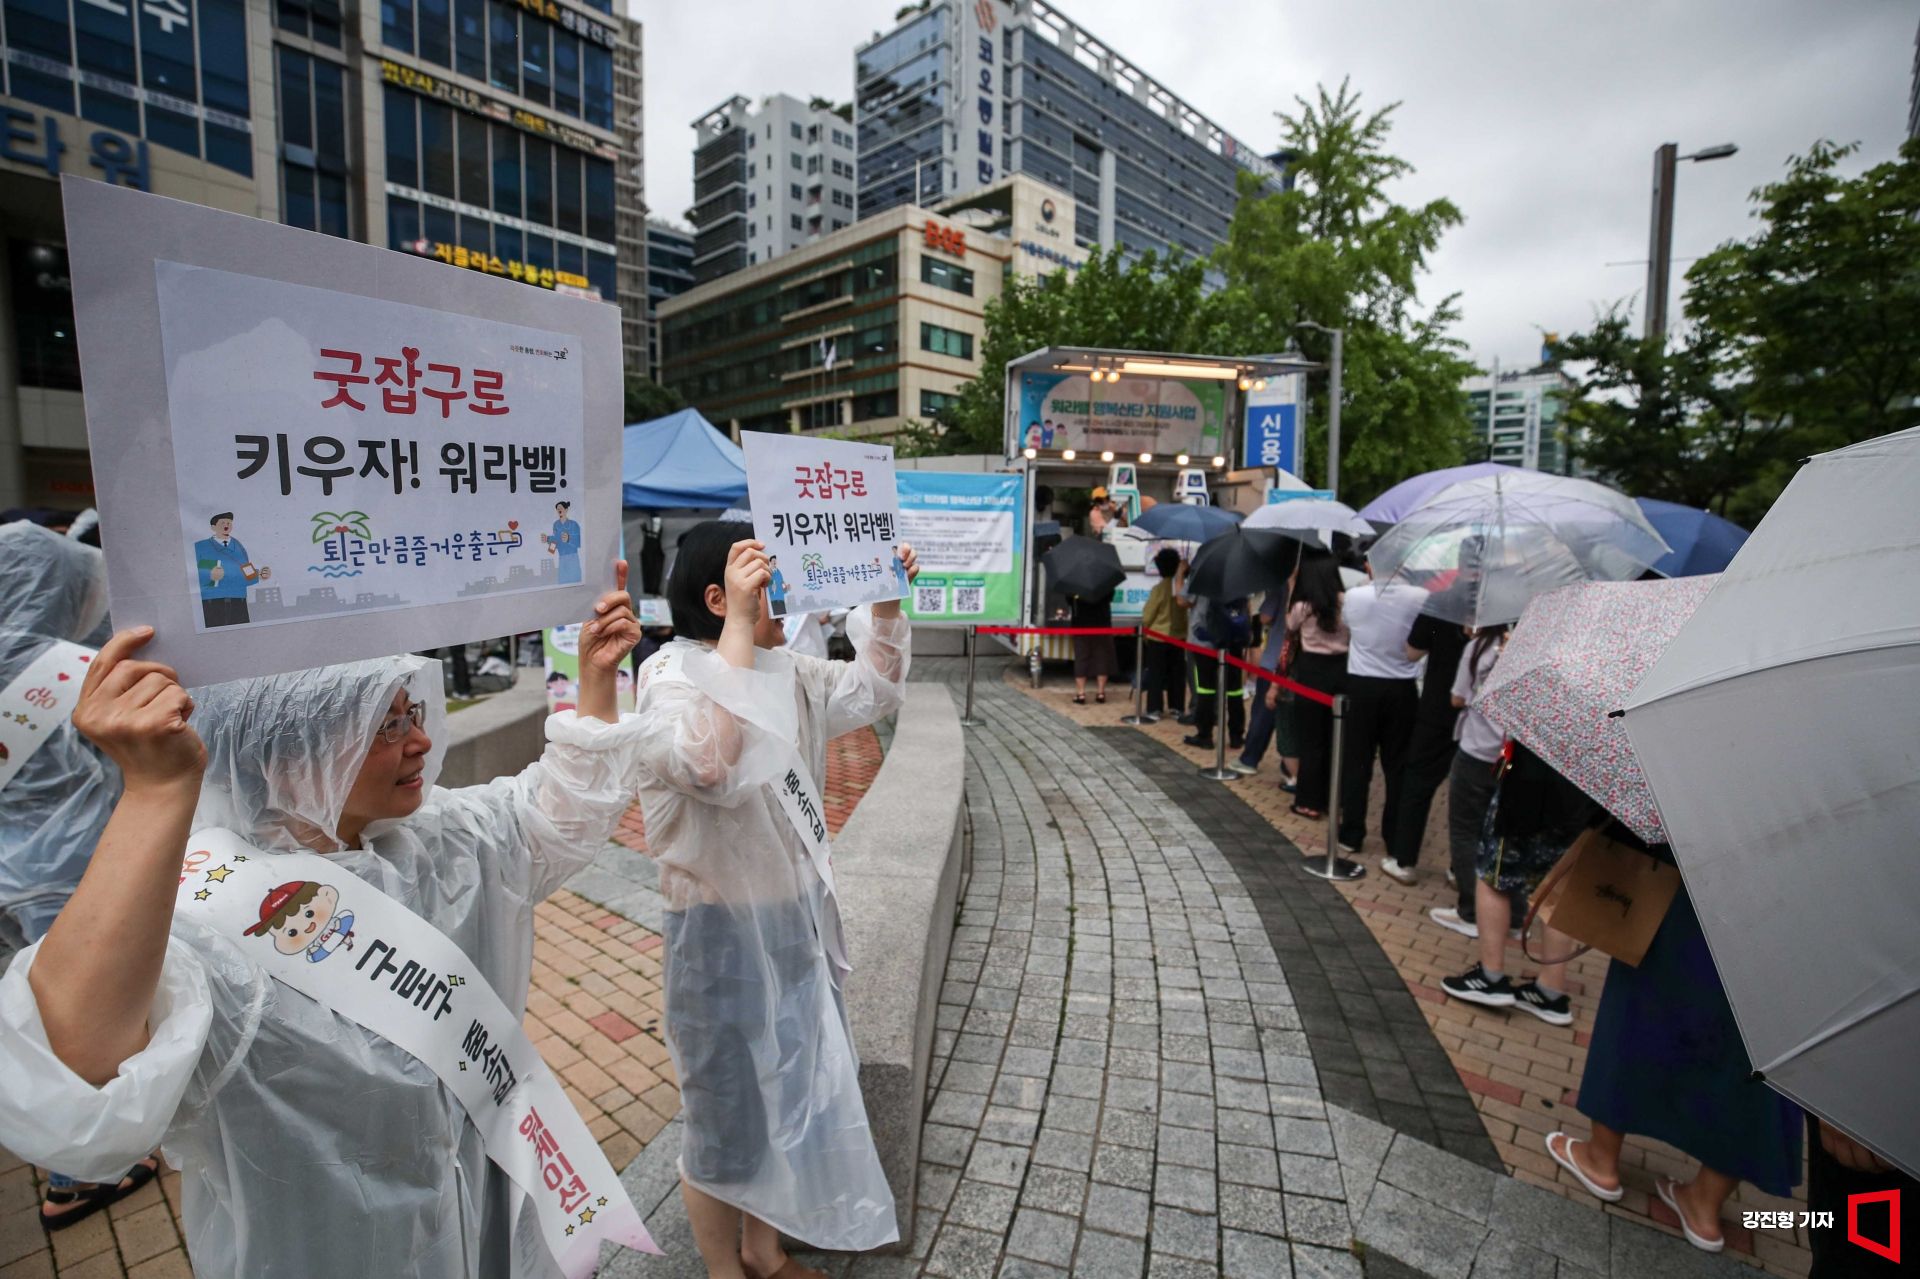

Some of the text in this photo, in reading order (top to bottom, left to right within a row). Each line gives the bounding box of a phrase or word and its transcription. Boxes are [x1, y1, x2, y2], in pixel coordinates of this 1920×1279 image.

[508, 259, 555, 288] 부동산
[314, 347, 510, 418] 굿잡구로
[235, 433, 568, 496] 키우자! 워라밸!
[1260, 413, 1282, 466] 신용
[795, 462, 868, 500] 굿잡구로
[772, 512, 896, 546] 키우자! 워라밸!
[784, 768, 825, 844] 중소기업
[355, 939, 592, 1215] 구로구 중소기업 워케이션
